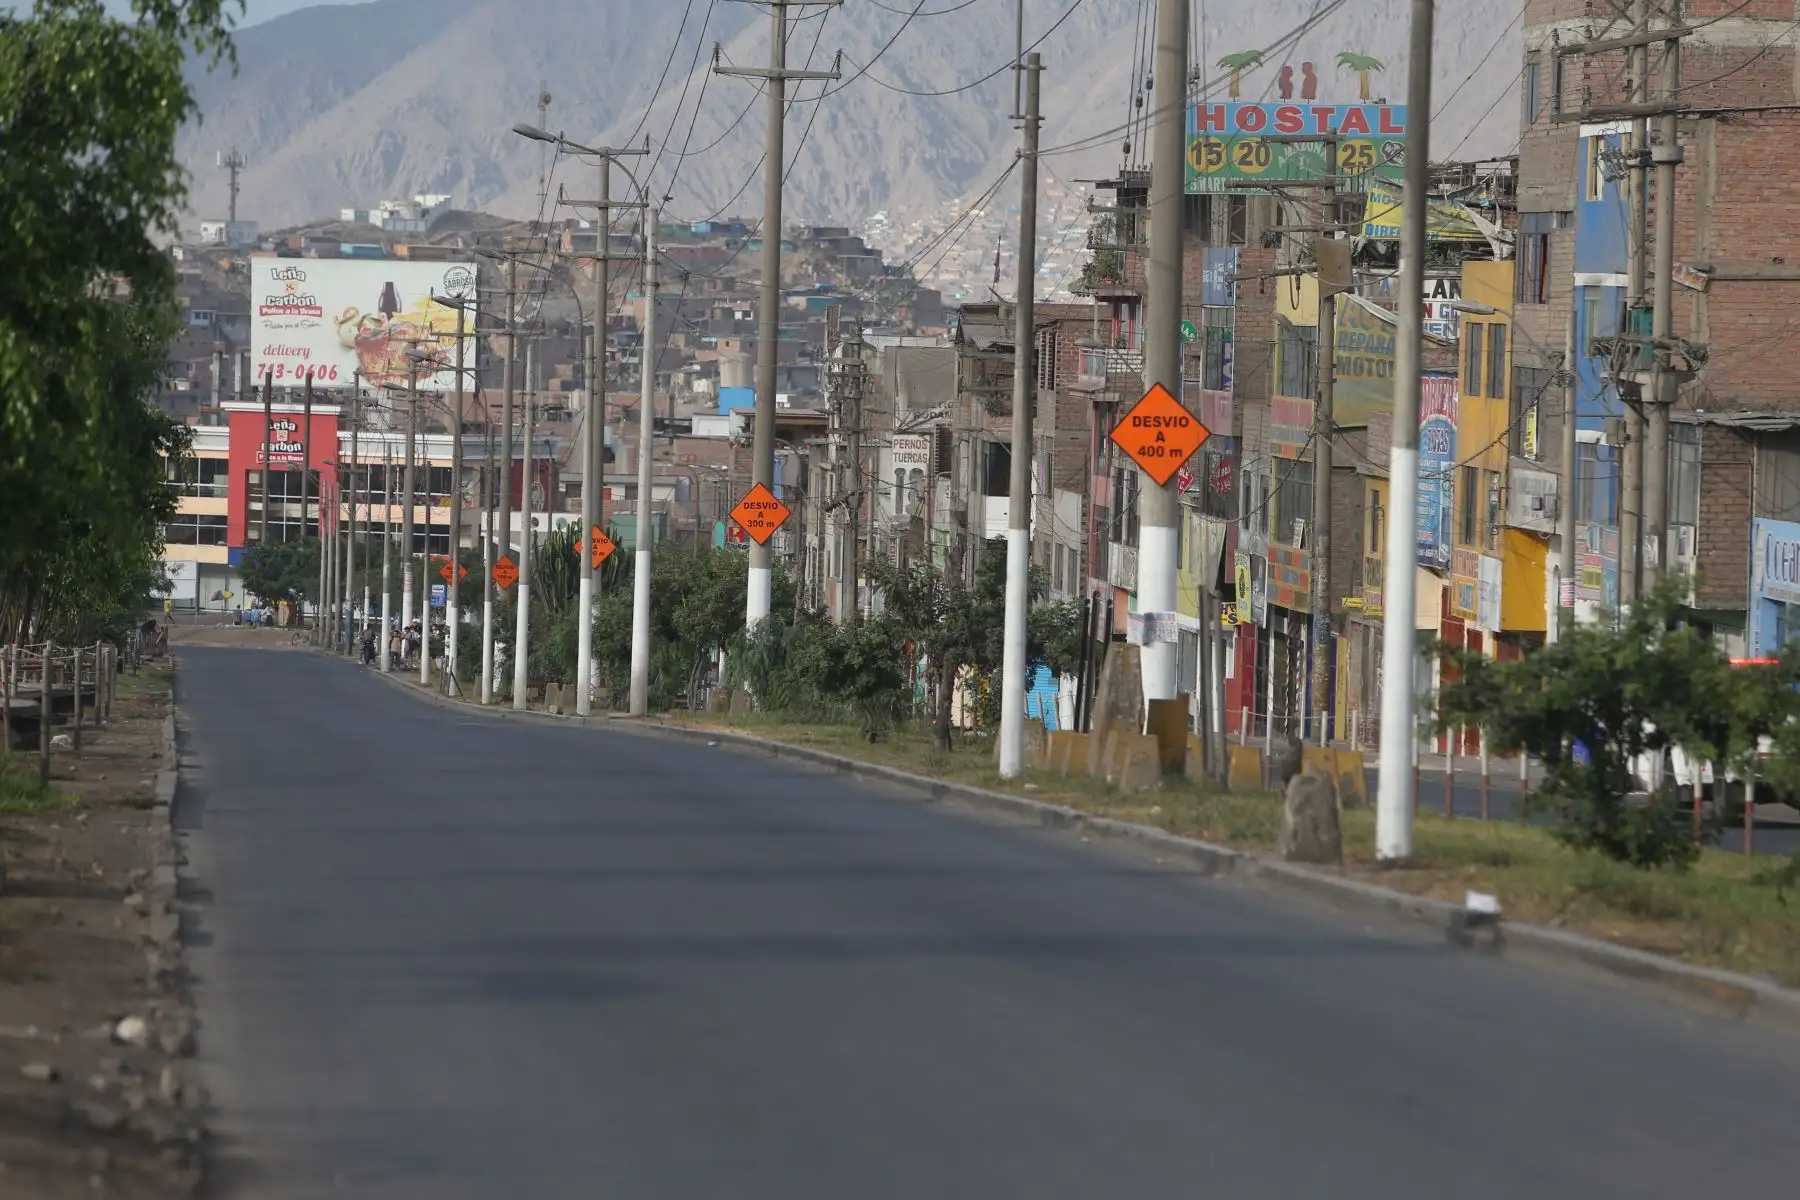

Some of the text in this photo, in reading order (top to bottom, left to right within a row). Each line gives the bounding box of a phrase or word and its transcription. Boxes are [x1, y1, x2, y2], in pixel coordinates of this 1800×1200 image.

[1195, 102, 1405, 135] HOSTAL
[1191, 141, 1271, 167] 15 20
[1341, 143, 1373, 167] 25
[271, 266, 306, 282] Leña
[443, 276, 474, 290] SABROSO
[263, 344, 311, 359] delivery
[257, 362, 337, 380] 713-0606
[270, 418, 297, 432] eña
[1132, 415, 1189, 428] DESVIO
[1155, 431, 1166, 443] A
[893, 439, 928, 450] PERNOS
[1137, 446, 1183, 457] 400 m
[893, 453, 928, 463] TUERCAS
[743, 502, 778, 510] DESVIO
